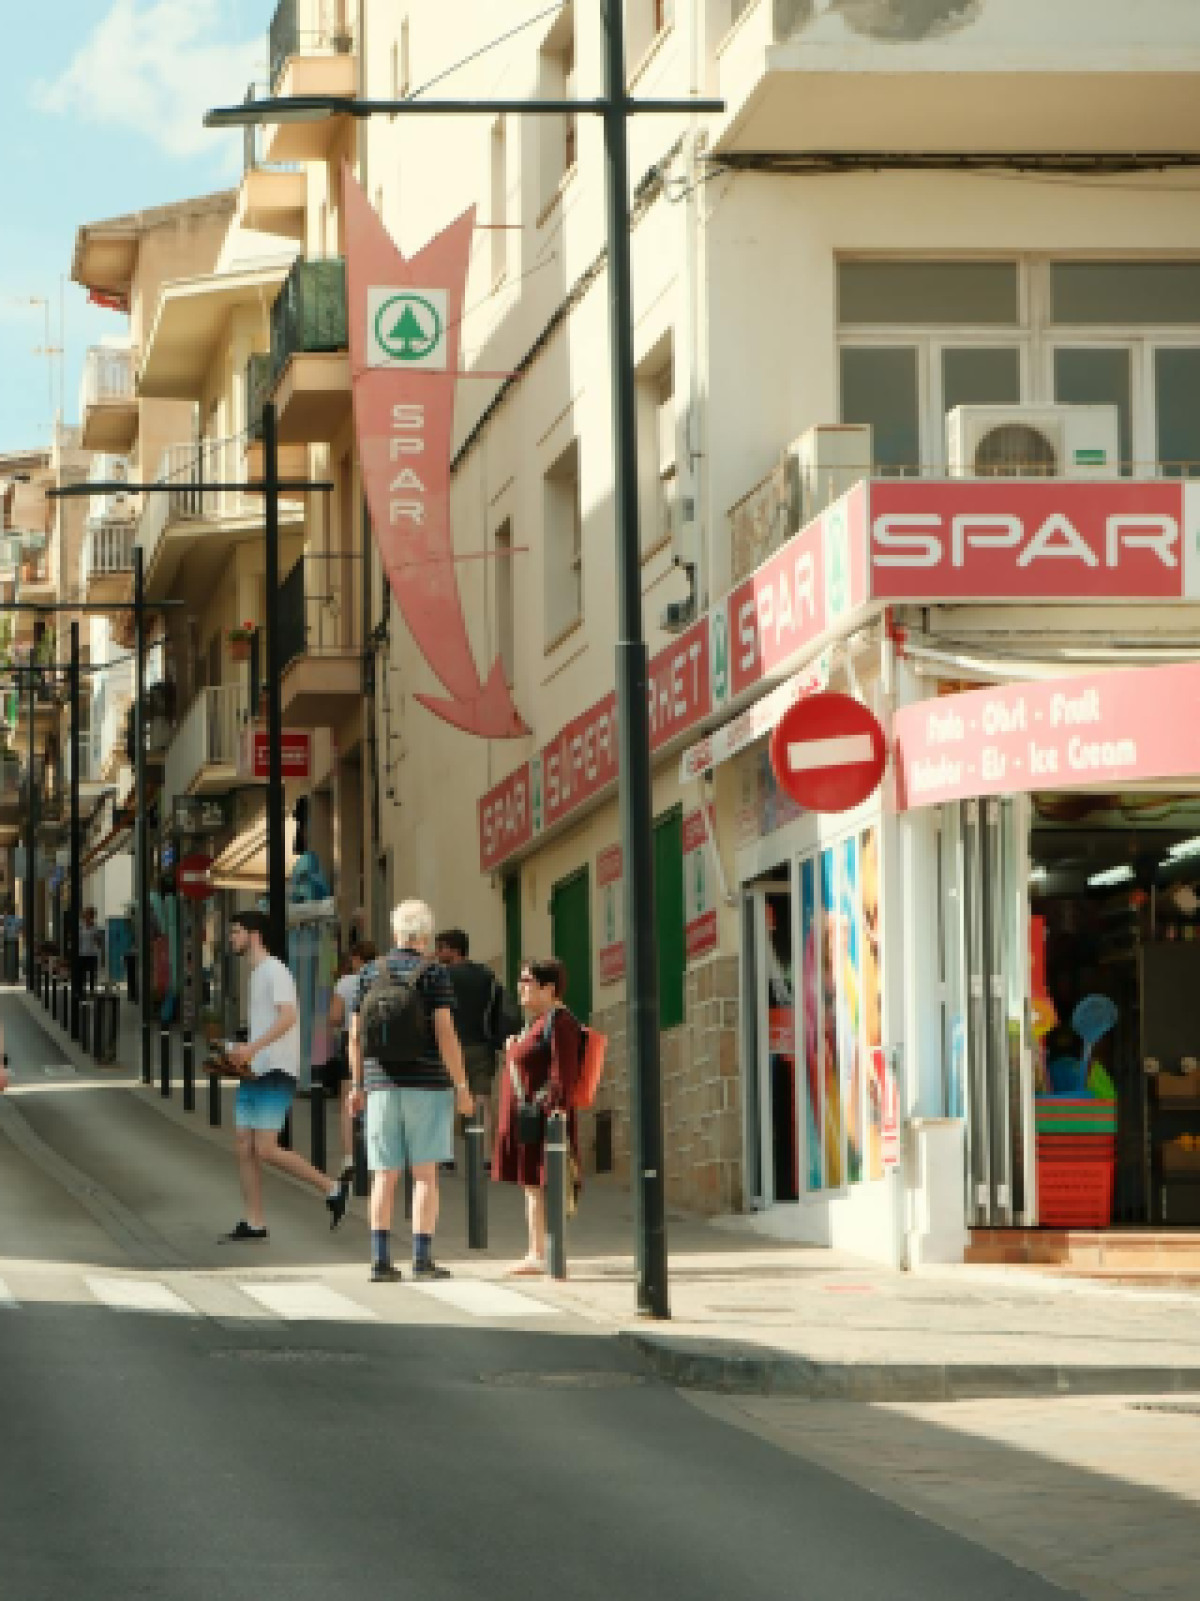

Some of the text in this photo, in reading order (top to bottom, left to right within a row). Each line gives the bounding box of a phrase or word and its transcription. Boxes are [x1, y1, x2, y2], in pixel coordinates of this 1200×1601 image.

[389, 404, 427, 526] SPAR
[872, 513, 1179, 568] SPAR
[737, 551, 817, 674] SPAR
[1029, 740, 1058, 775] Ice
[1067, 735, 1137, 770] Cream
